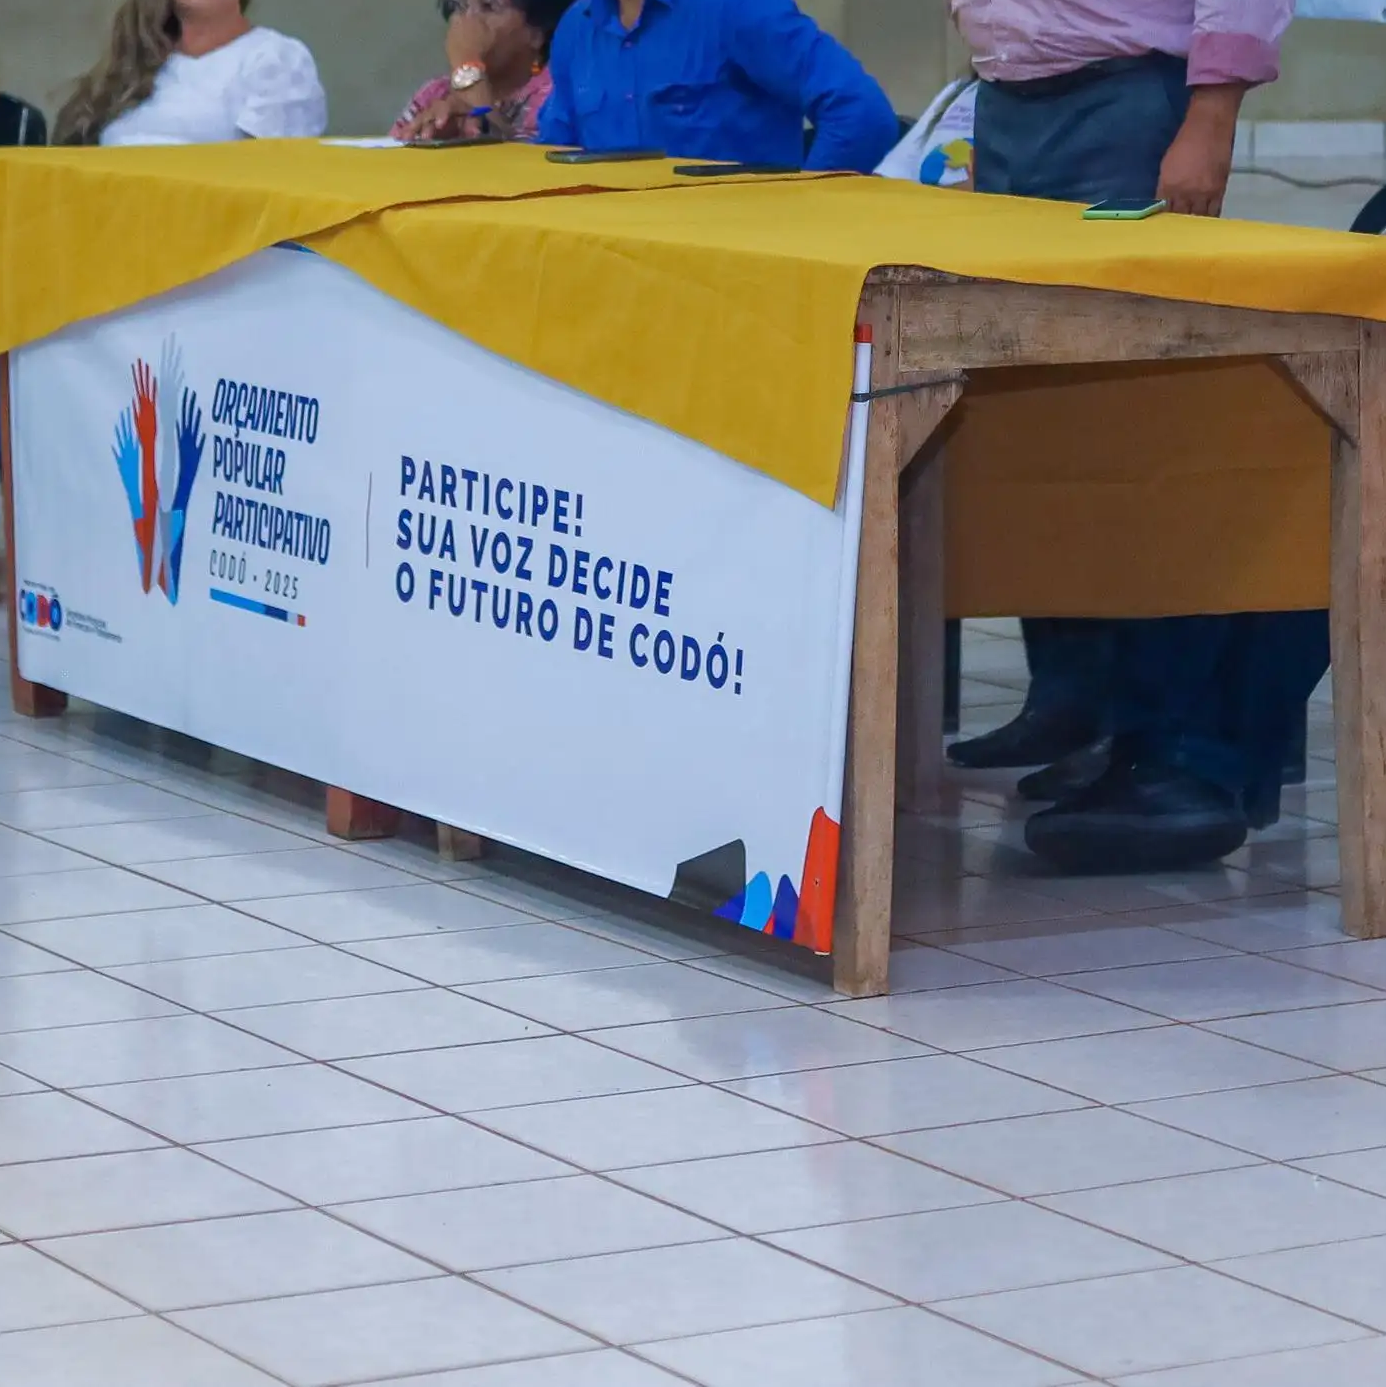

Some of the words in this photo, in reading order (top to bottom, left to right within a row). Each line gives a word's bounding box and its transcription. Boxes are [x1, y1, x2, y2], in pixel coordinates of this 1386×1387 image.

[211, 378, 320, 444] ORÇAMENTO
[213, 434, 286, 495] POPULAR
[400, 455, 584, 537] PARTICIPE!
[212, 491, 331, 565] PARTICIPATIVO
[396, 508, 457, 563] SUA
[470, 525, 534, 582] VOZ
[548, 543, 673, 618] DECIDE
[209, 549, 247, 585] CODÓ
[265, 569, 299, 600] 2025
[395, 561, 414, 603] O
[429, 568, 559, 642] FUTURO
[573, 606, 615, 660] DE
[629, 623, 744, 696] CODÓ!
